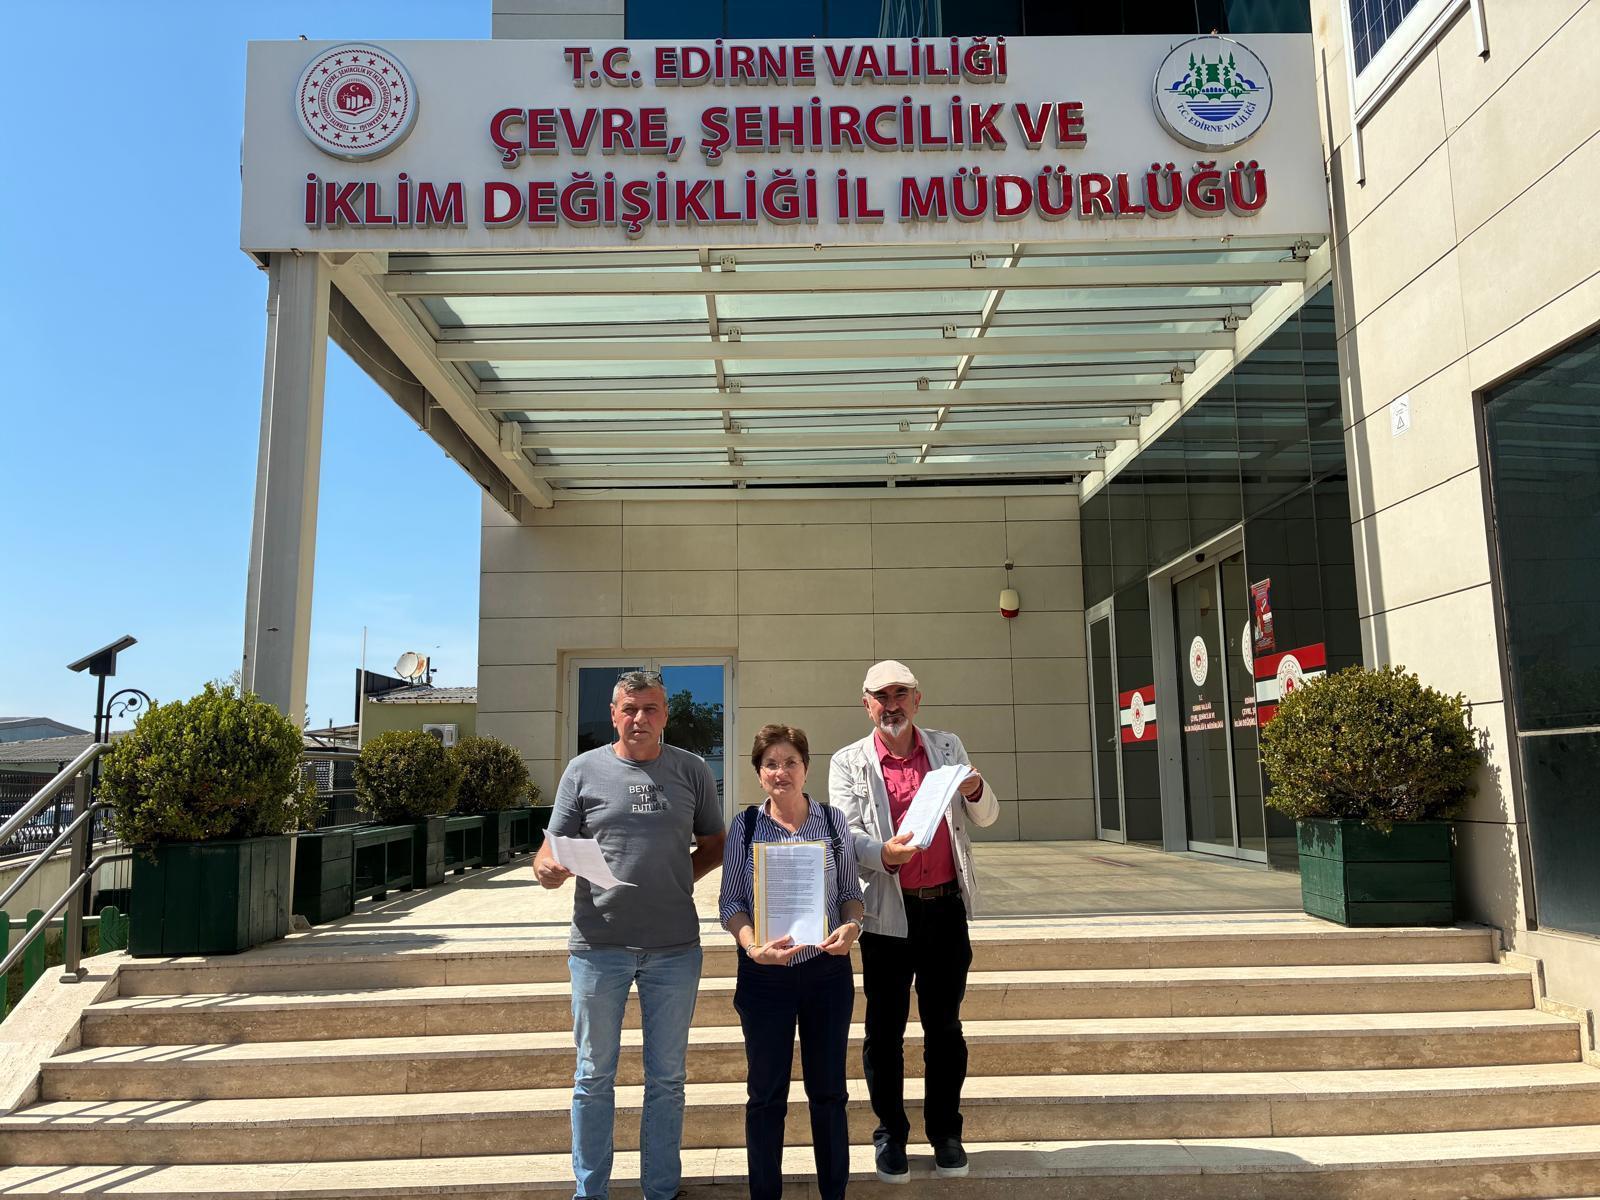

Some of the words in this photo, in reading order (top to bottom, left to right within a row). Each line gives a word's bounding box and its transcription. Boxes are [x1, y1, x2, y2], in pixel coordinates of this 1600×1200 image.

[564, 47, 641, 82] T.C.
[655, 39, 816, 81] EDİRNE
[824, 37, 1007, 80] VALİLİĞİ
[490, 107, 685, 163] ÇEVRE,
[700, 96, 1006, 161] ŞEHİRCİLİK
[1014, 102, 1087, 148] VE
[1177, 103, 1189, 119] T.C.
[1188, 117, 1224, 132] EDİRNE
[1224, 101, 1256, 130] VALİLİĞİ
[305, 172, 467, 226] İKLİM
[483, 168, 818, 234] DEĞİŞİKLİĞİ
[836, 169, 885, 222] İL
[899, 161, 1268, 221] MÜDÜRLÜĞÜ
[629, 784, 664, 794] BEYOND
[639, 793, 658, 803] THE
